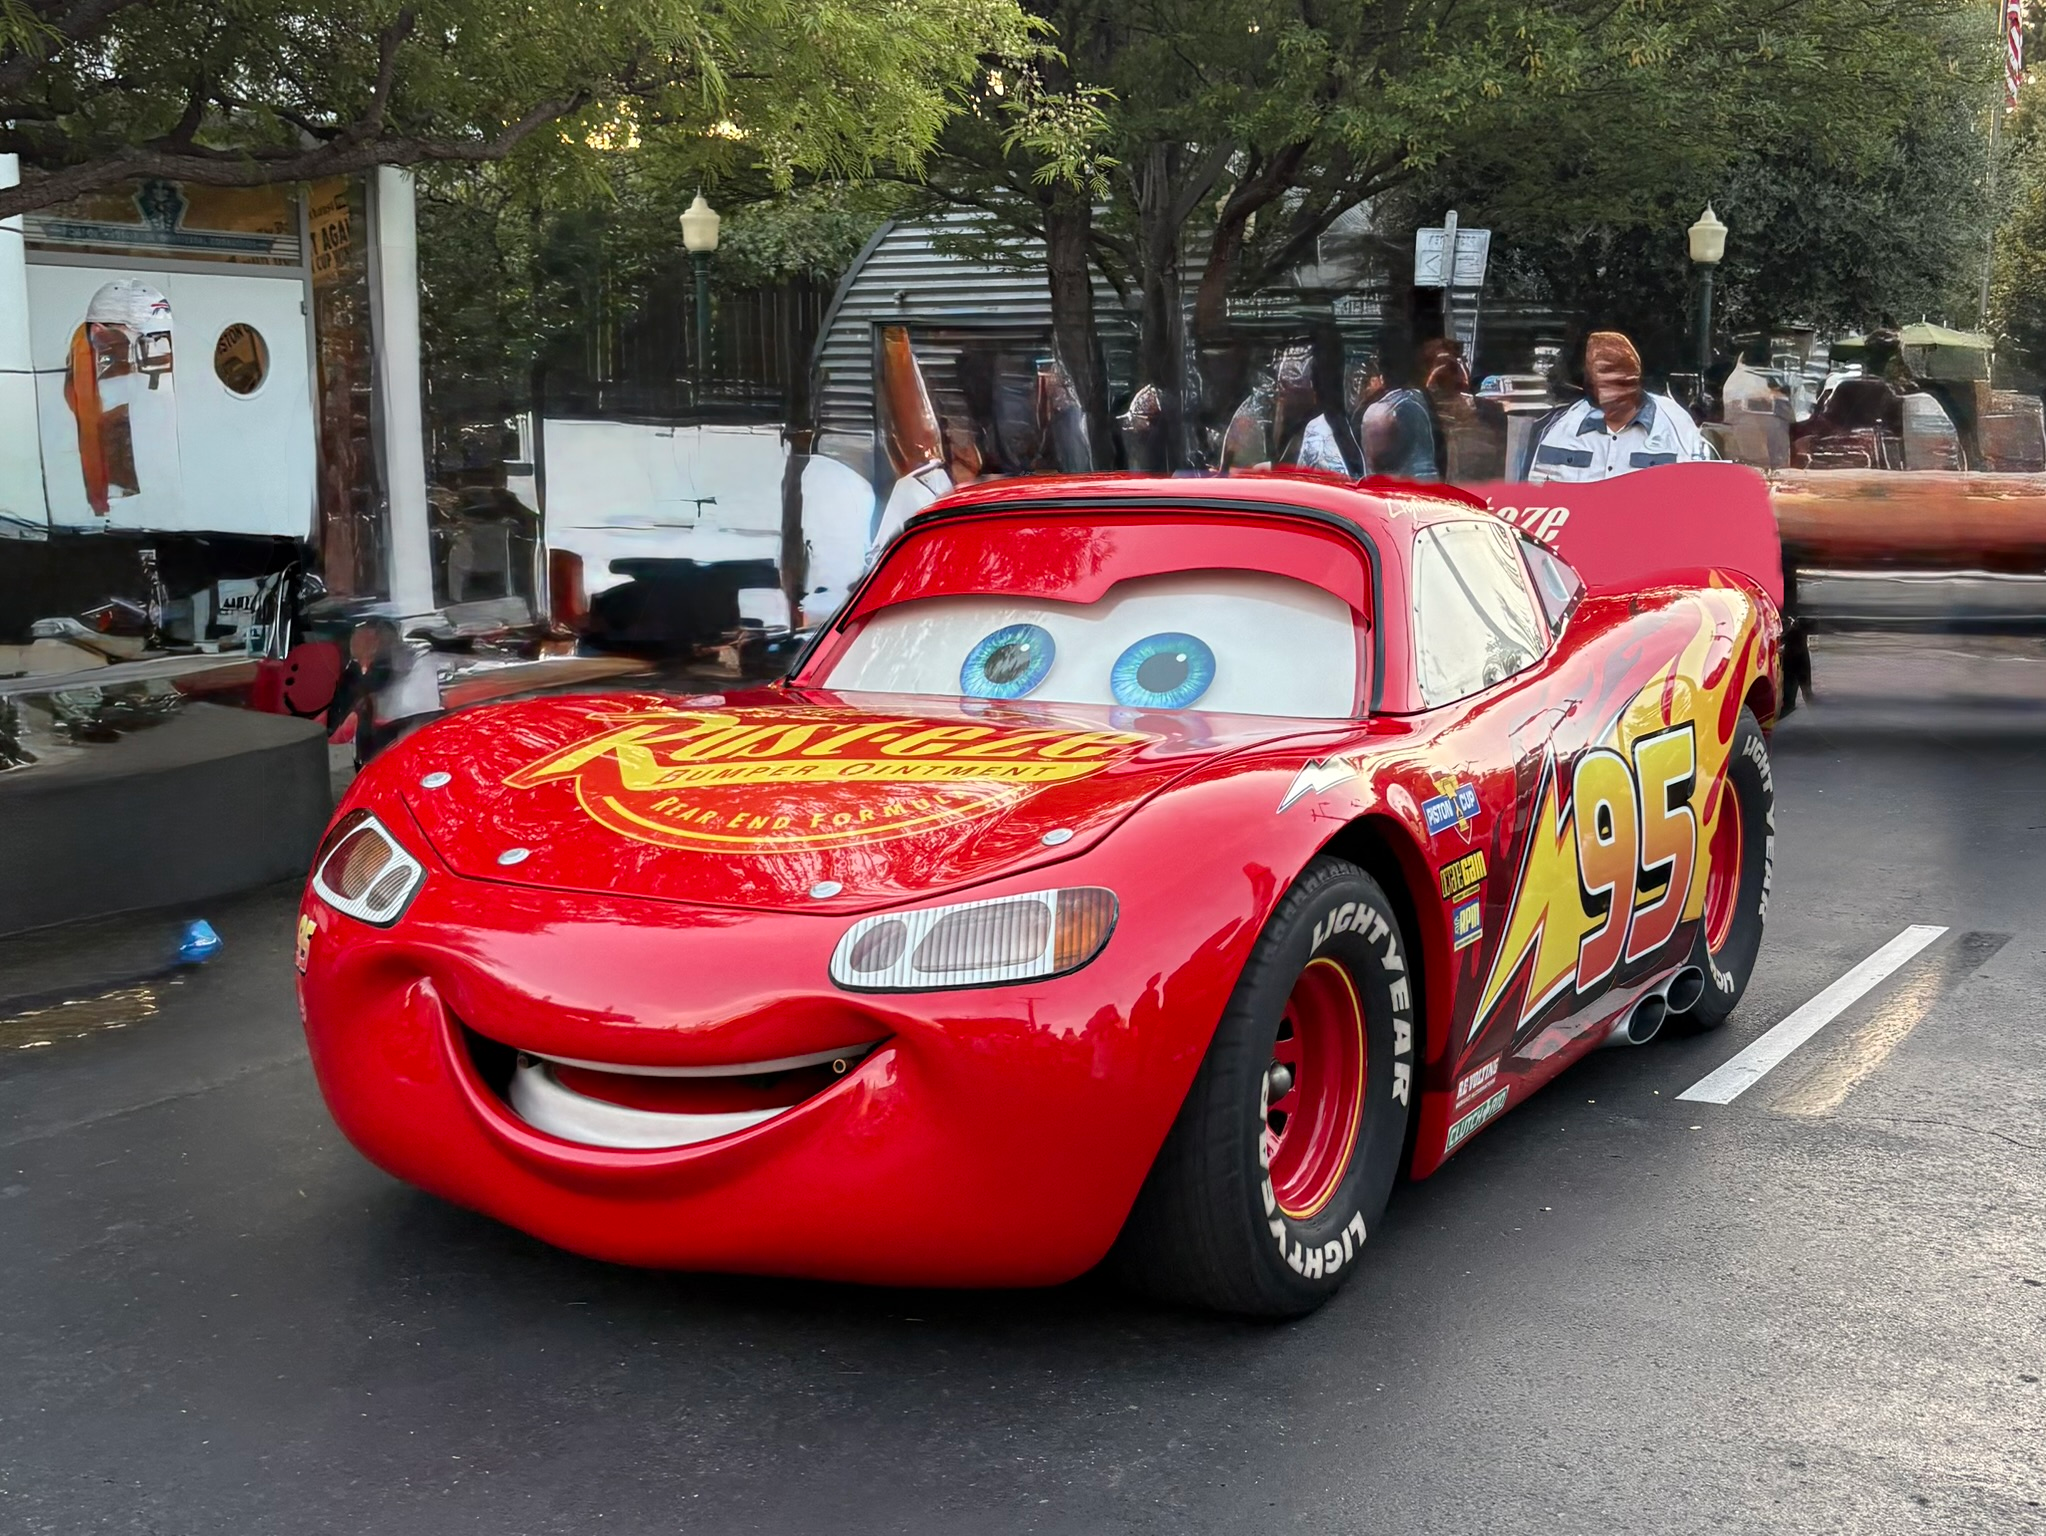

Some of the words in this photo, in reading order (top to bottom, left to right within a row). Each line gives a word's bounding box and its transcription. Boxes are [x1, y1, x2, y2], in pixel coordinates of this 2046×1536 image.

[652, 764, 819, 786] BUMPER
[839, 761, 1057, 778] OINTMENT
[649, 795, 719, 826] REAR
[726, 811, 791, 831] END
[1426, 799, 1454, 827] PISTON
[1459, 789, 1476, 812] CUP
[1571, 720, 1697, 995] 95
[1309, 900, 1412, 1109] LIGHTYEAR
[1449, 1107, 1485, 1146] CLUTCH
